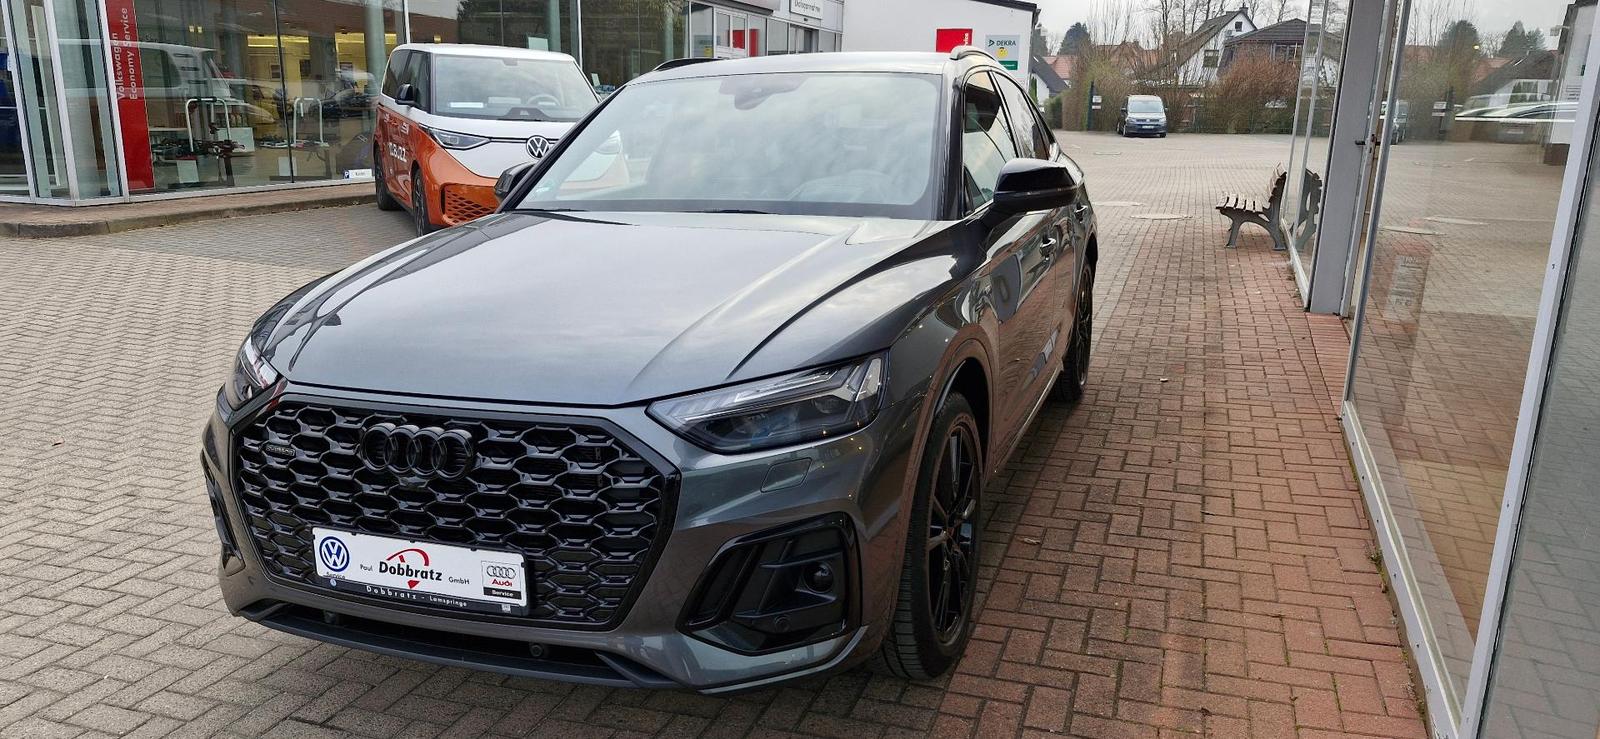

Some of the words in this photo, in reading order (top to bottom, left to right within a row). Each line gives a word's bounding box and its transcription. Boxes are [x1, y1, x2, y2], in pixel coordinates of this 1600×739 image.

[121, 8, 131, 47] Service
[112, 33, 125, 100] Volkswagen
[127, 51, 138, 99] Economy
[360, 564, 373, 572] Paul
[379, 561, 443, 582] Dobbratz
[448, 576, 470, 585] GmbH
[492, 579, 513, 588] Audi
[366, 585, 417, 600] Dobbratz
[429, 595, 468, 607] Lamspringe
[492, 589, 514, 598] Service
